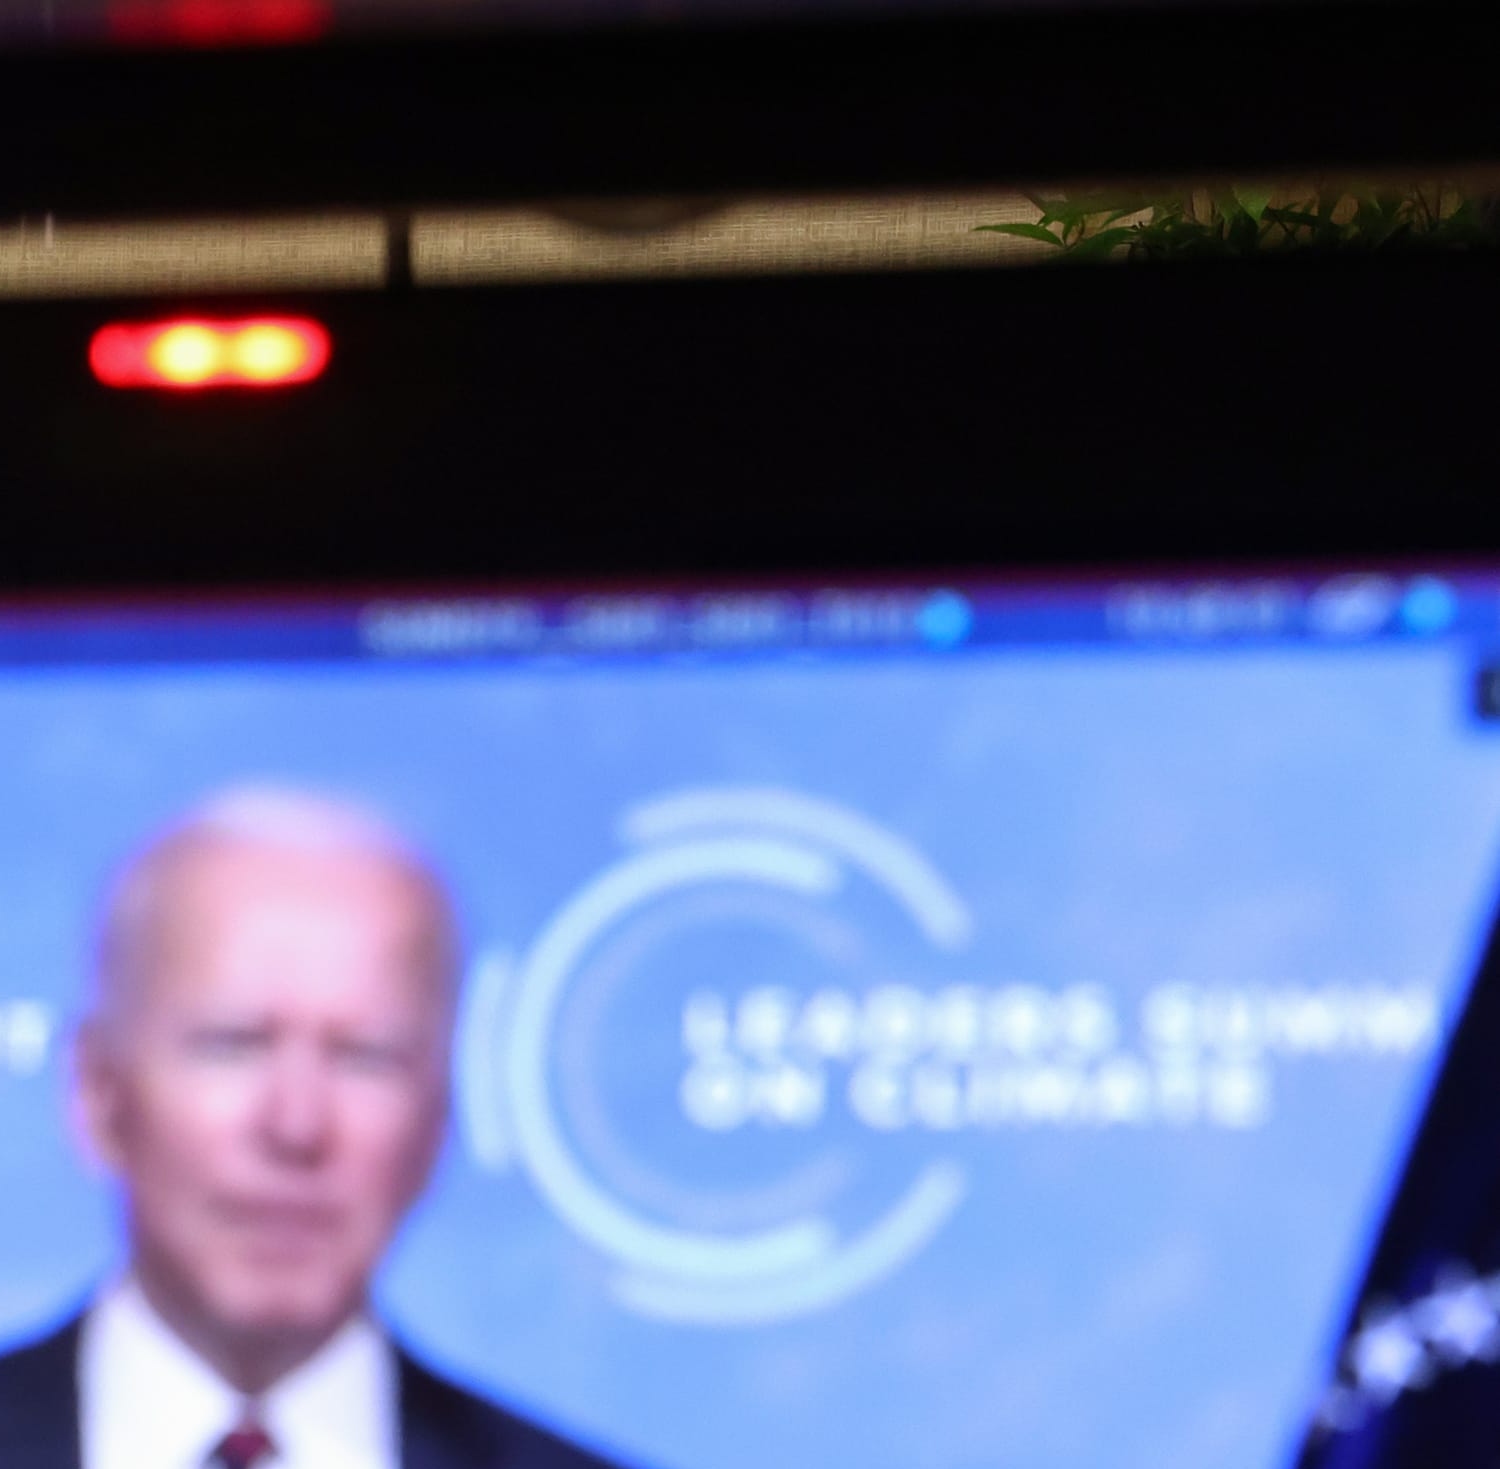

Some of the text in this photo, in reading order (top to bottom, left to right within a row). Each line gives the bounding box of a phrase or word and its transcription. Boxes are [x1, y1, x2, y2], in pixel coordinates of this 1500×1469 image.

[682, 984, 1434, 1060] LEADERS SUMM
[681, 1056, 1270, 1132] ON CLIMATE
